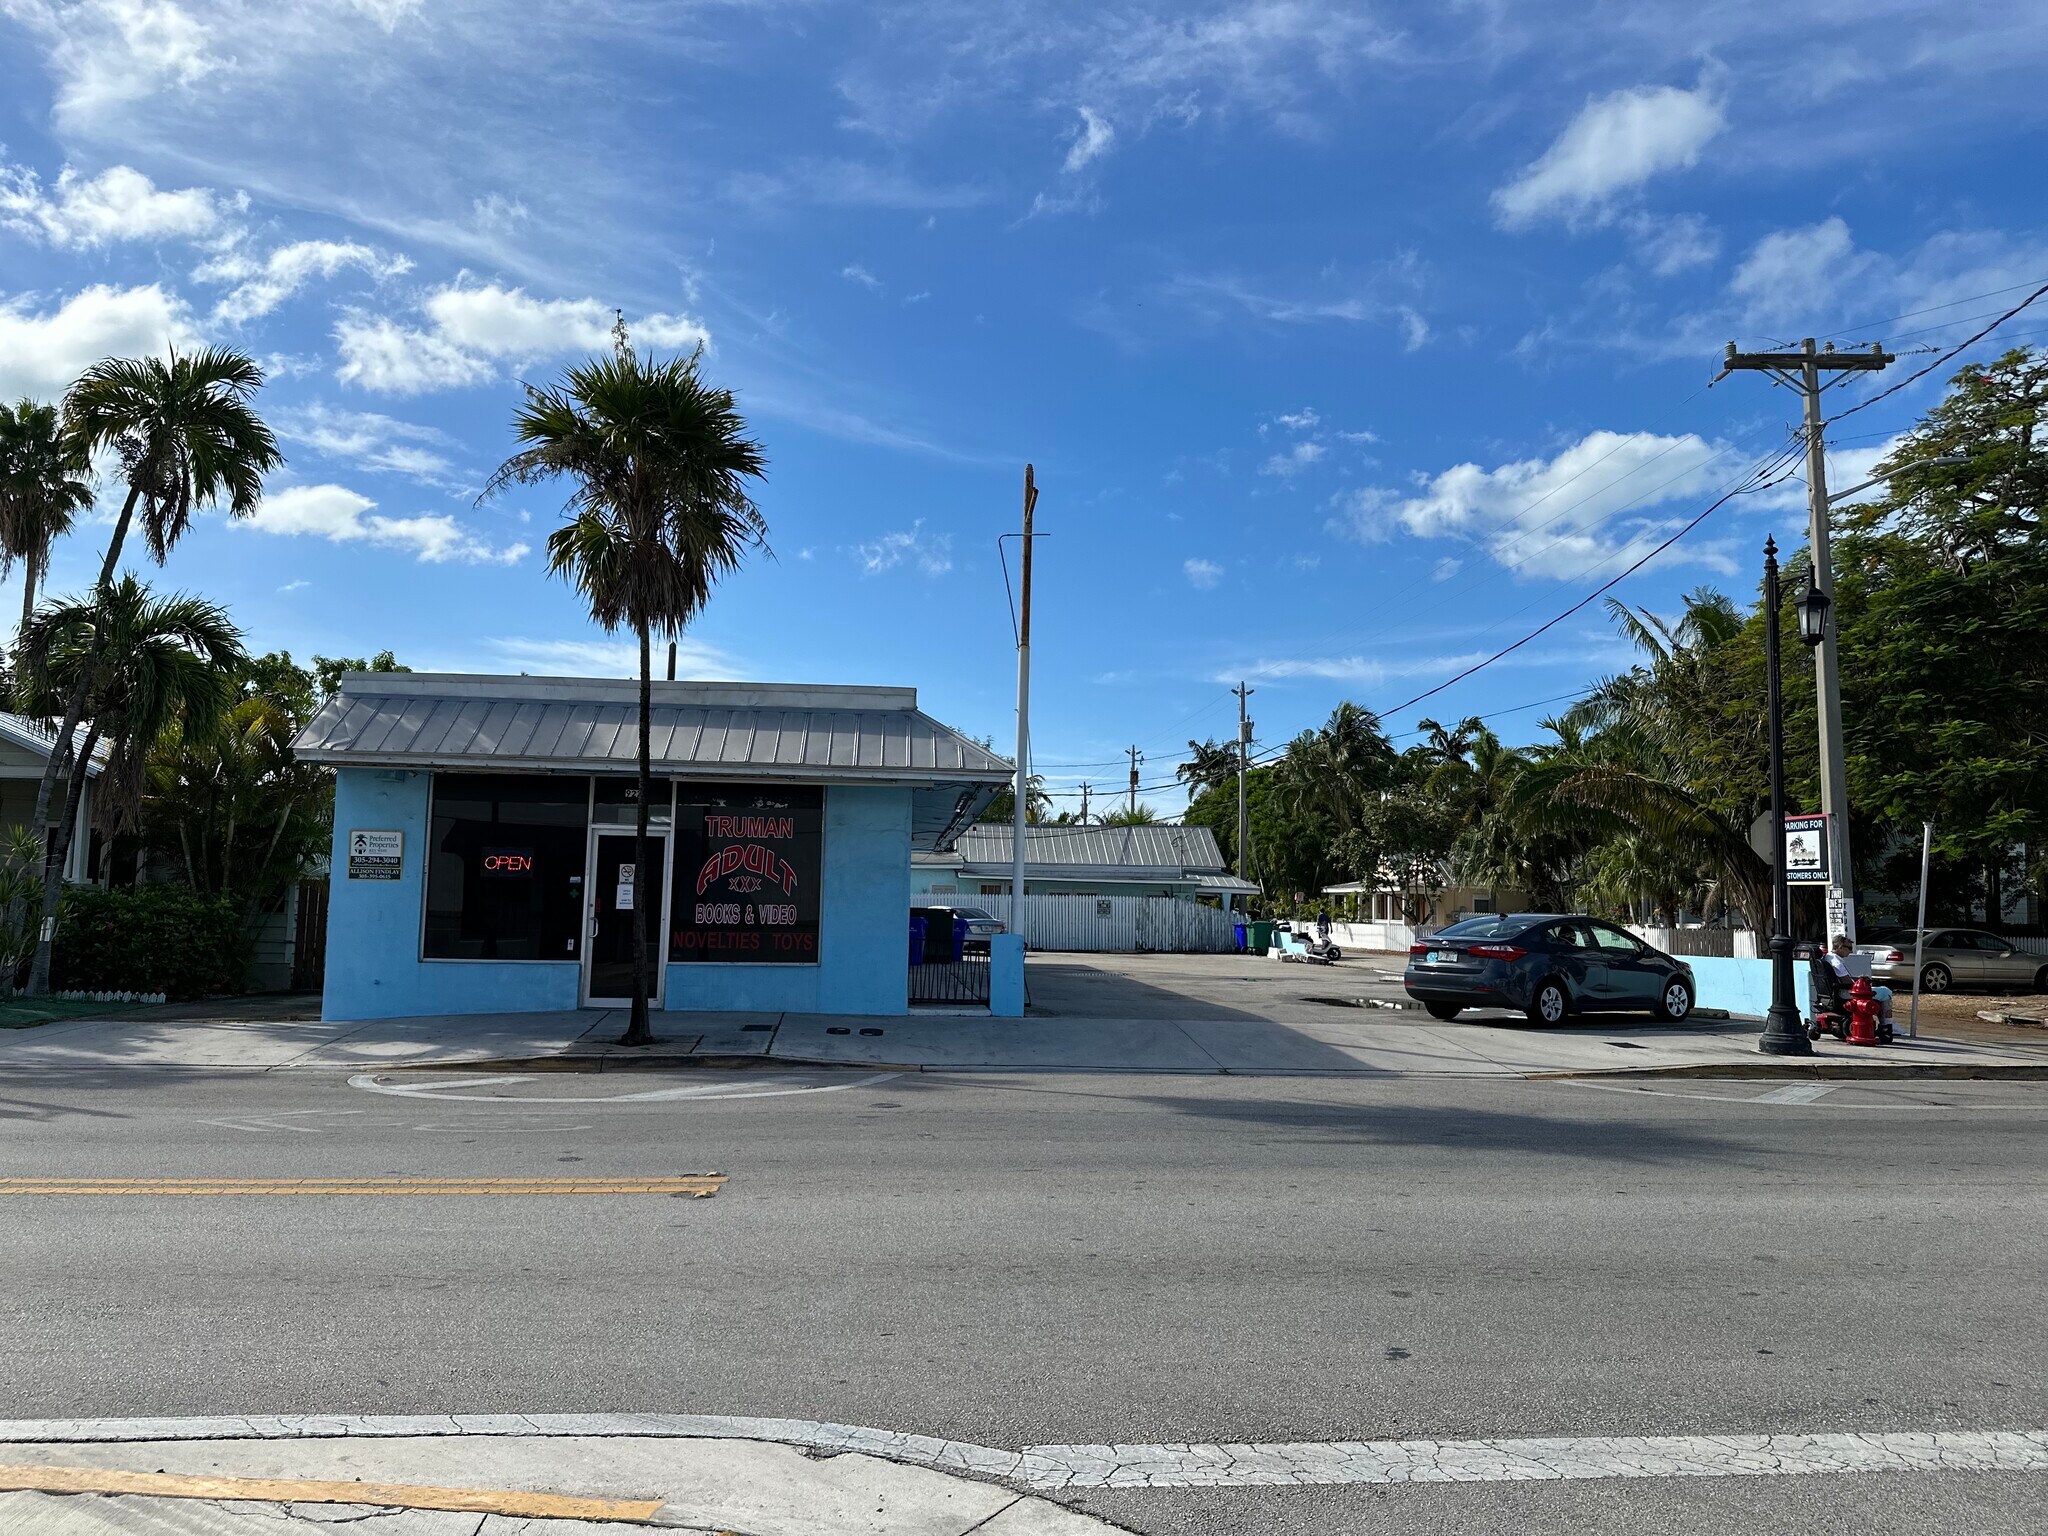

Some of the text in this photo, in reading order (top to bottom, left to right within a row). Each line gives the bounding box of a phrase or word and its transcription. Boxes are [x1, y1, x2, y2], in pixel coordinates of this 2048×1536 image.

[705, 816, 793, 838] TRUMAN
[1785, 820, 1823, 830] ARKING FOR
[485, 856, 531, 870] OPEN
[697, 844, 797, 896] ADULT
[728, 875, 762, 893] XXX
[695, 903, 797, 925] BOOKS & VIDEO
[673, 931, 813, 950] NOVELTIES TOYS
